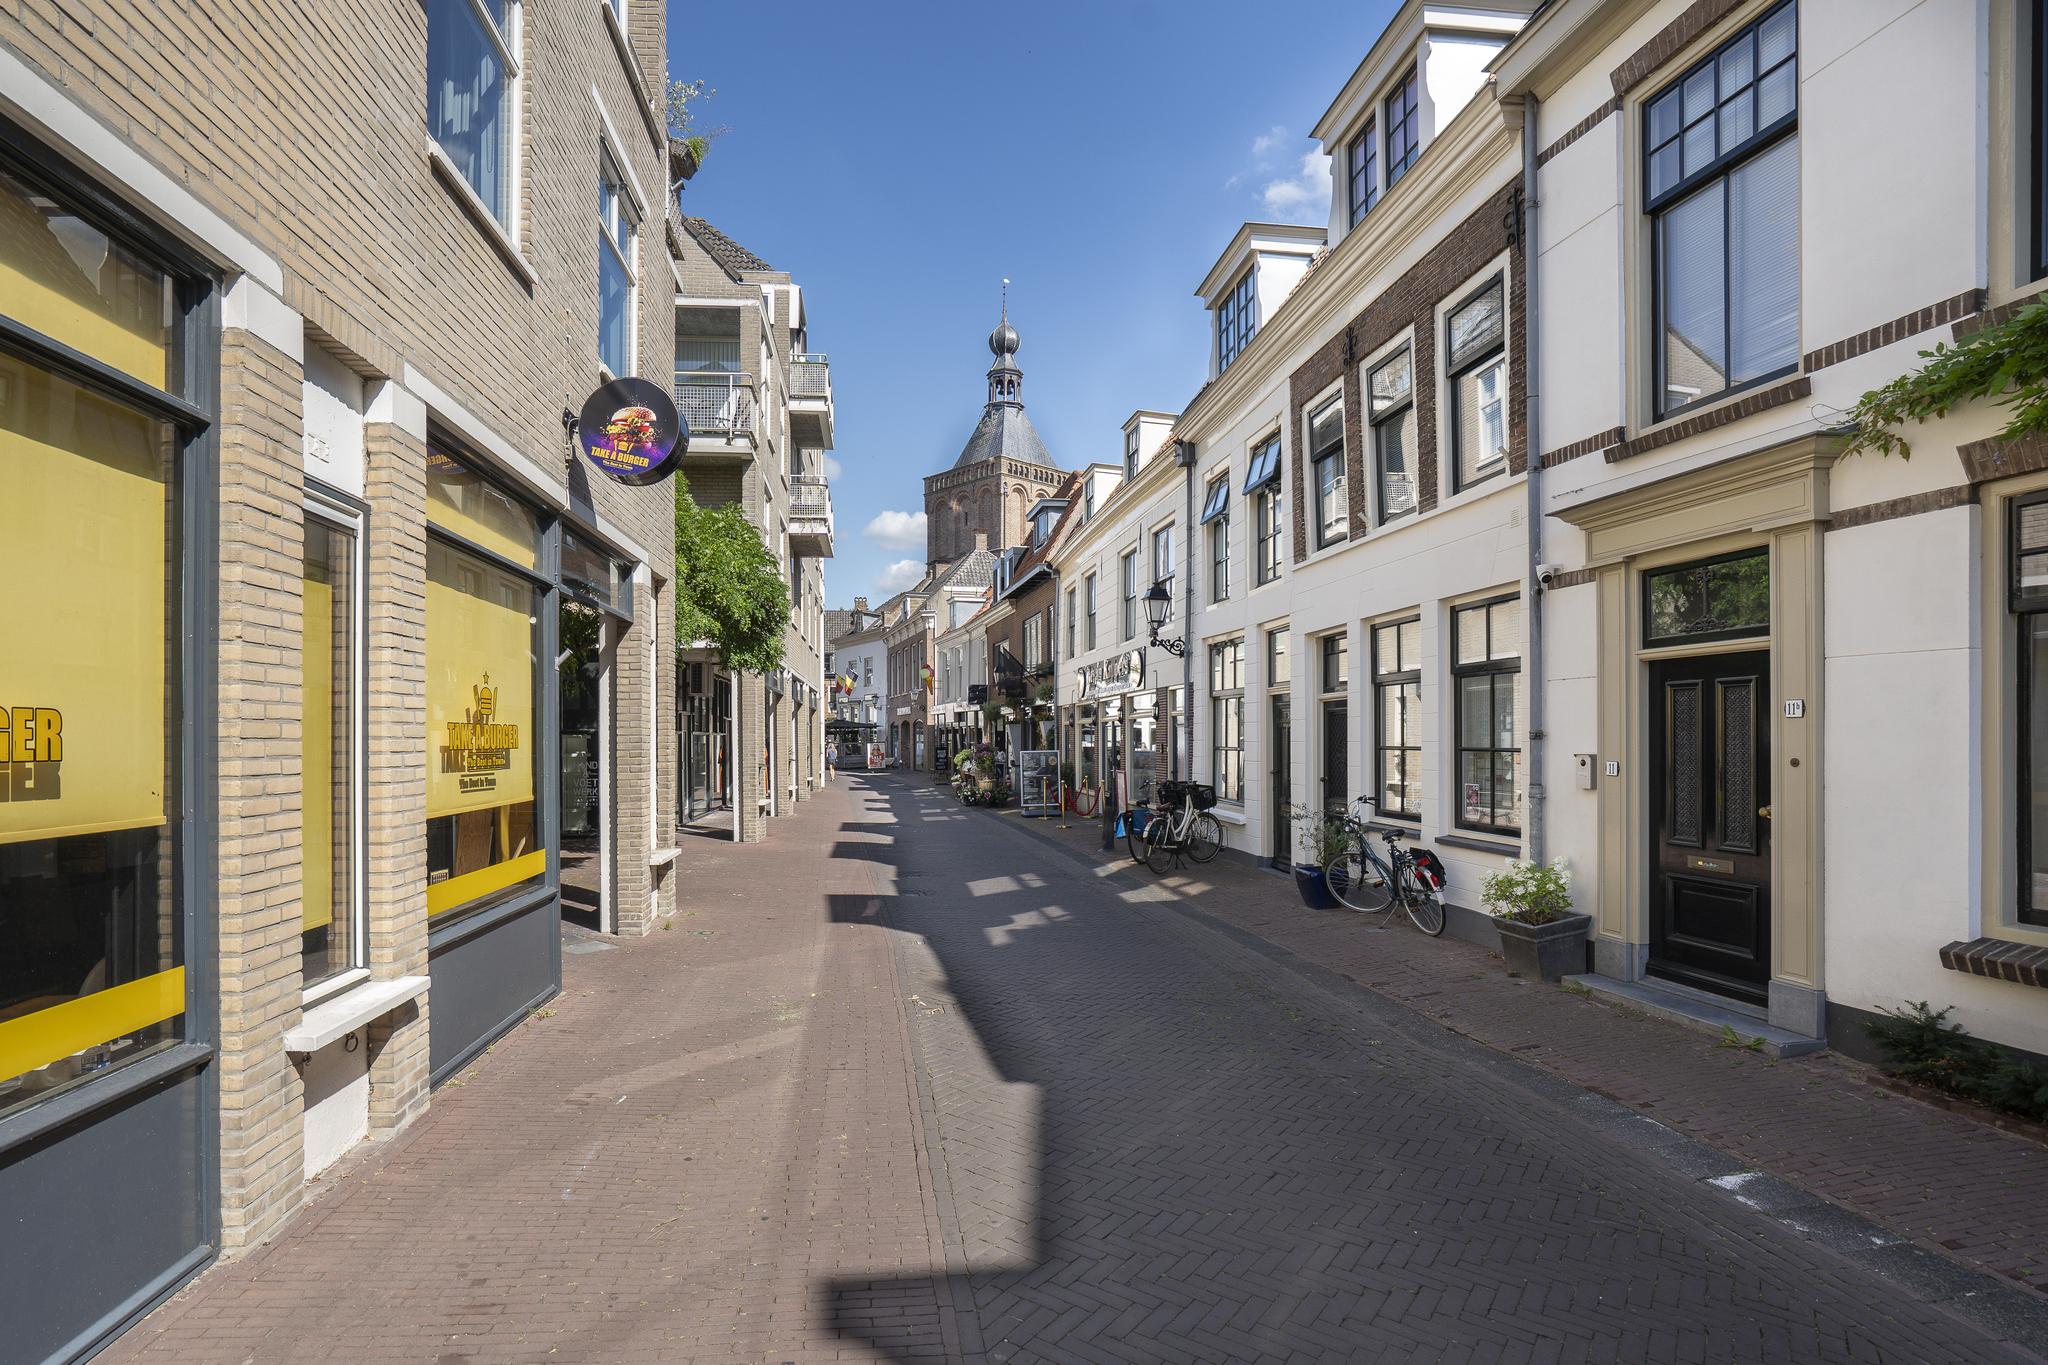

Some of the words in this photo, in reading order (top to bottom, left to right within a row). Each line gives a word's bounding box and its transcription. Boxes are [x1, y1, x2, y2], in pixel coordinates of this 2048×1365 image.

[591, 446, 610, 458] TAKE
[610, 451, 617, 460] A
[617, 452, 649, 468] BURGER
[447, 722, 474, 750] TAKE
[475, 723, 482, 750] A
[484, 723, 519, 750] BURGER
[1608, 763, 1615, 774] 11
